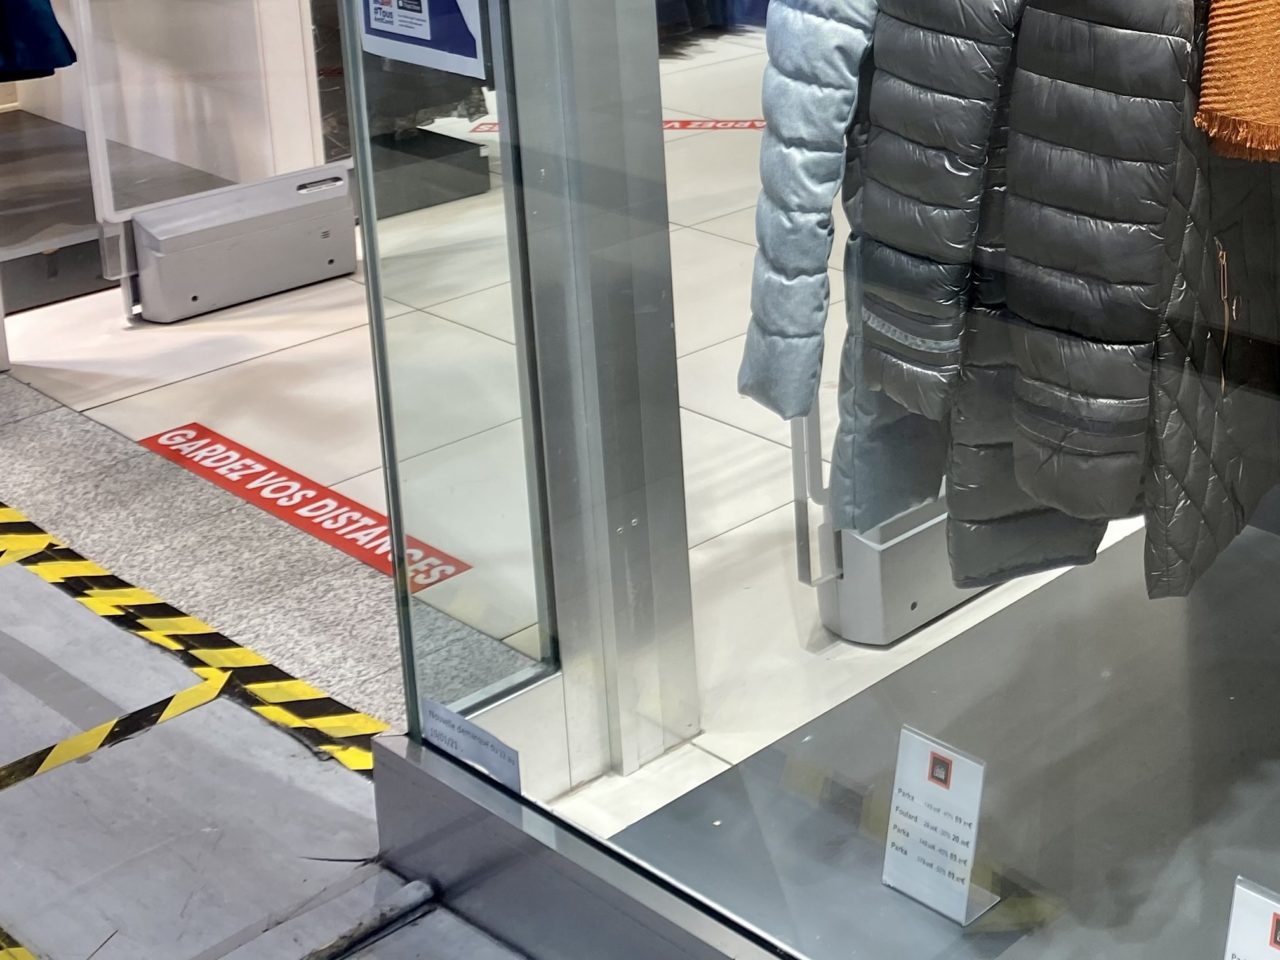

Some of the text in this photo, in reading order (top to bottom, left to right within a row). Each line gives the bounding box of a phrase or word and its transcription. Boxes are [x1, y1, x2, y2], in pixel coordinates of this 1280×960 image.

[158, 428, 264, 481] GARDEZ
[245, 471, 316, 507] VOS
[898, 788, 914, 801] Parka
[896, 806, 918, 822] Foulard
[893, 824, 909, 838] Parka
[891, 842, 908, 856] Parka
